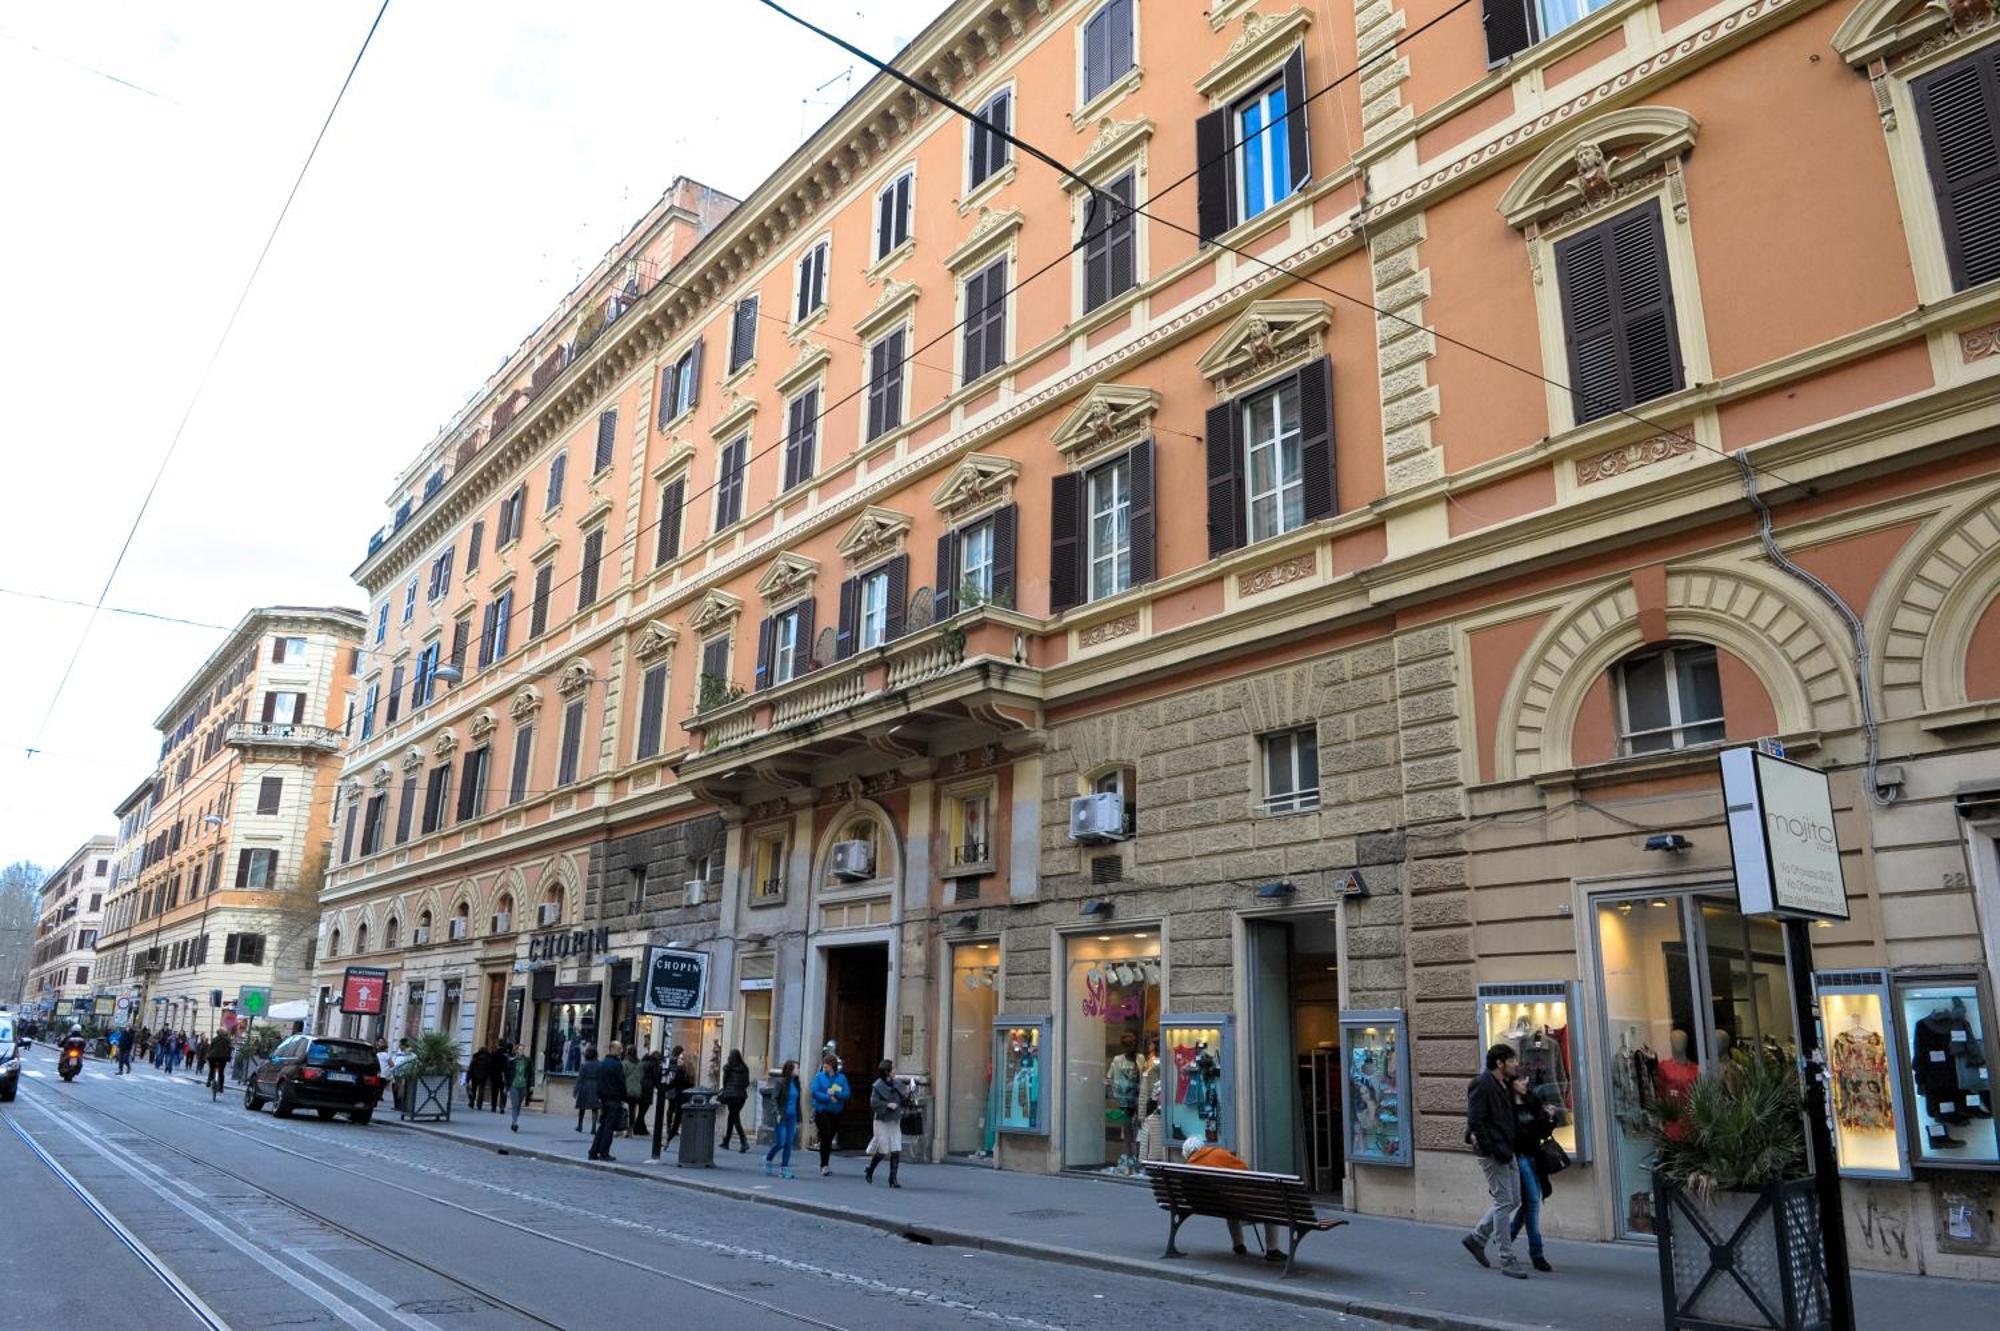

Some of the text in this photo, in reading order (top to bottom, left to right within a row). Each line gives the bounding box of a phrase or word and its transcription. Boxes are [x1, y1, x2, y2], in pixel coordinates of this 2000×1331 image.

[1767, 812, 1833, 843] mojito
[1943, 872, 1966, 888] 22
[528, 927, 609, 962] CHOPIN
[656, 960, 700, 972] CHOPIN
